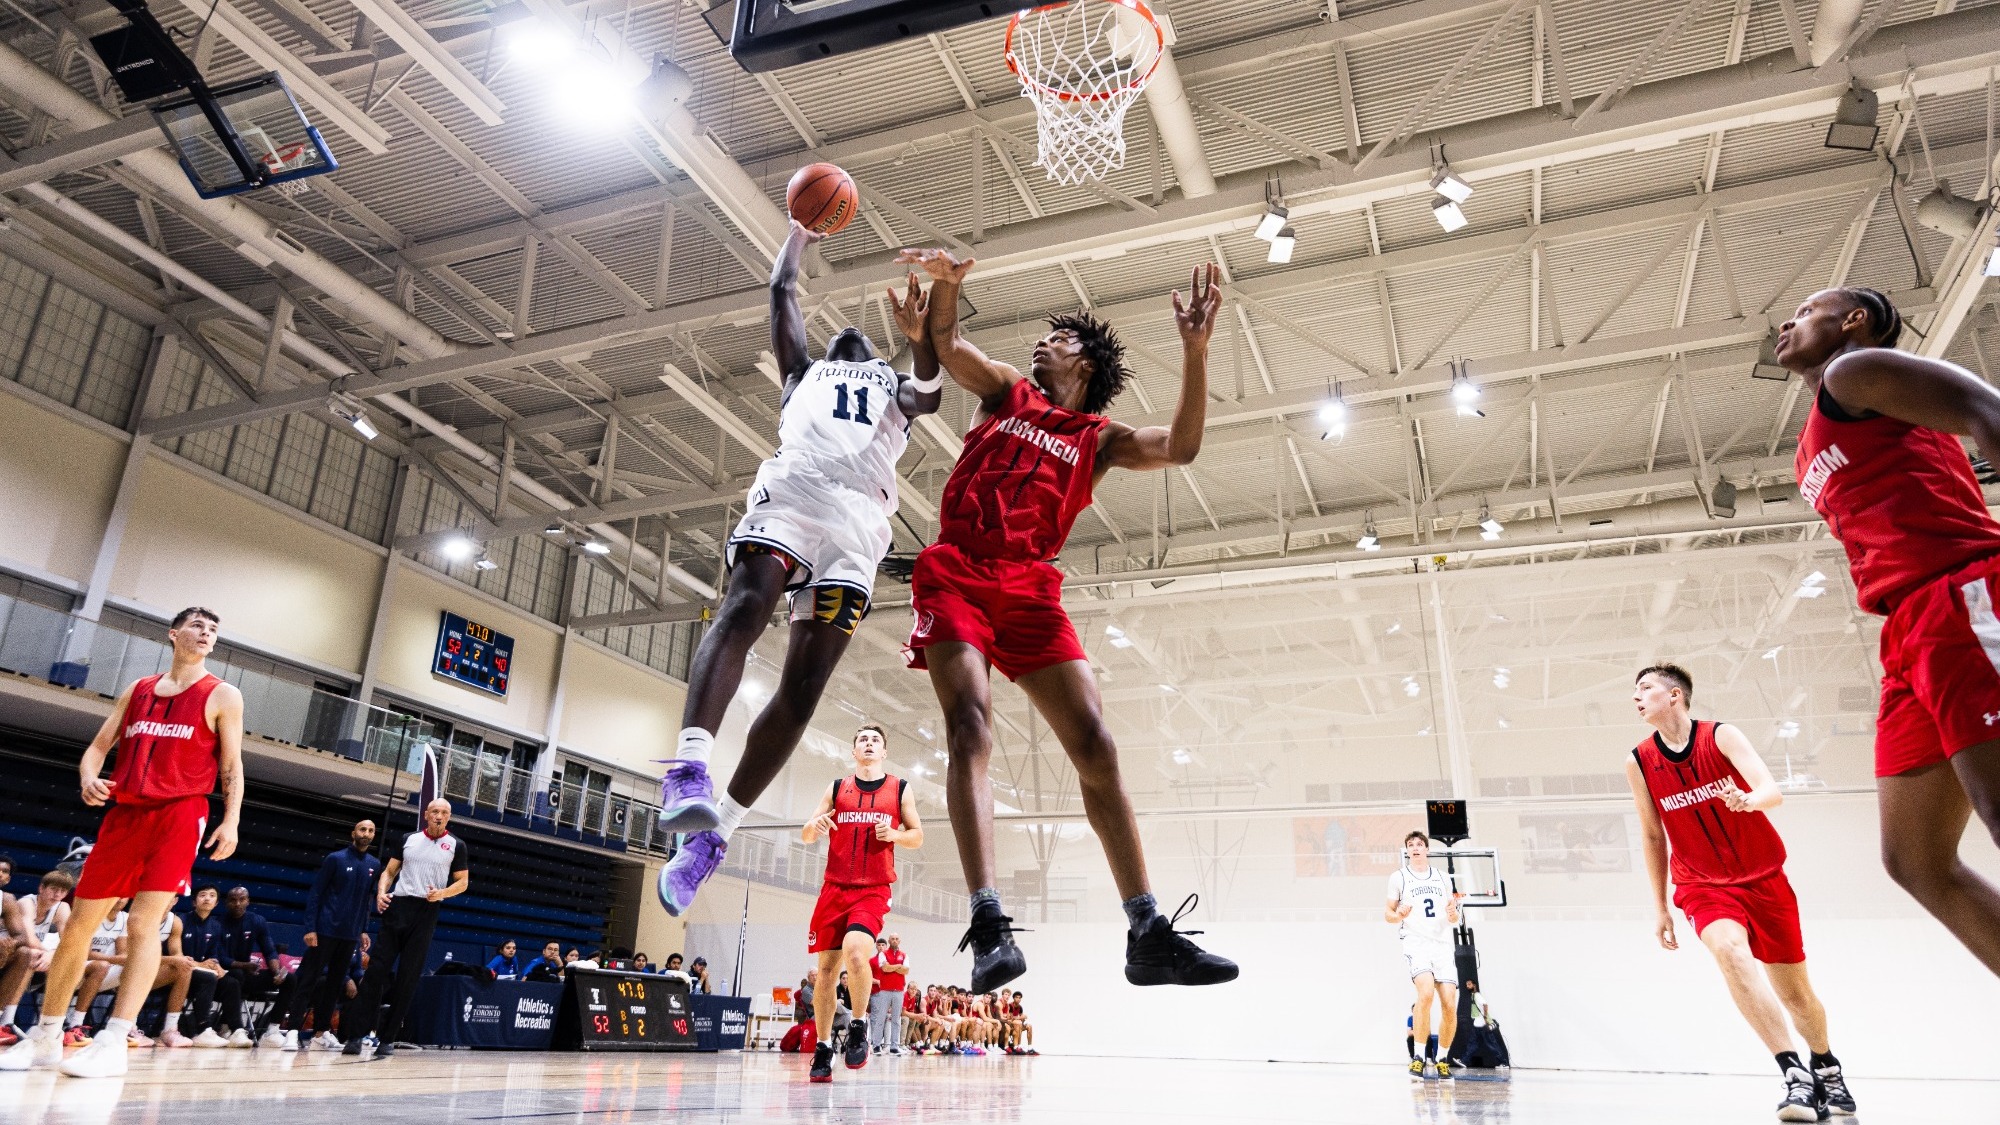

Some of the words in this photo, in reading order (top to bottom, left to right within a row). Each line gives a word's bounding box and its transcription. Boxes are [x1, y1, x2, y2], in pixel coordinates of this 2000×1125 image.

[813, 199, 847, 233] Wilson
[833, 382, 873, 426] 11
[468, 622, 489, 641] 47.0
[447, 638, 462, 655] 52
[473, 649, 481, 661] 2
[494, 656, 508, 673] 40
[549, 791, 559, 807] C
[615, 809, 624, 824] C
[1429, 803, 1456, 815] 47.0
[1410, 885, 1443, 898] TORONTO
[1423, 898, 1436, 918] 2
[618, 981, 645, 1000] 47.0
[517, 997, 550, 1015] Athletics
[514, 1012, 552, 1030] Recreation
[594, 1015, 609, 1034] 52
[637, 1018, 645, 1037] 2
[673, 1018, 688, 1036] 40
